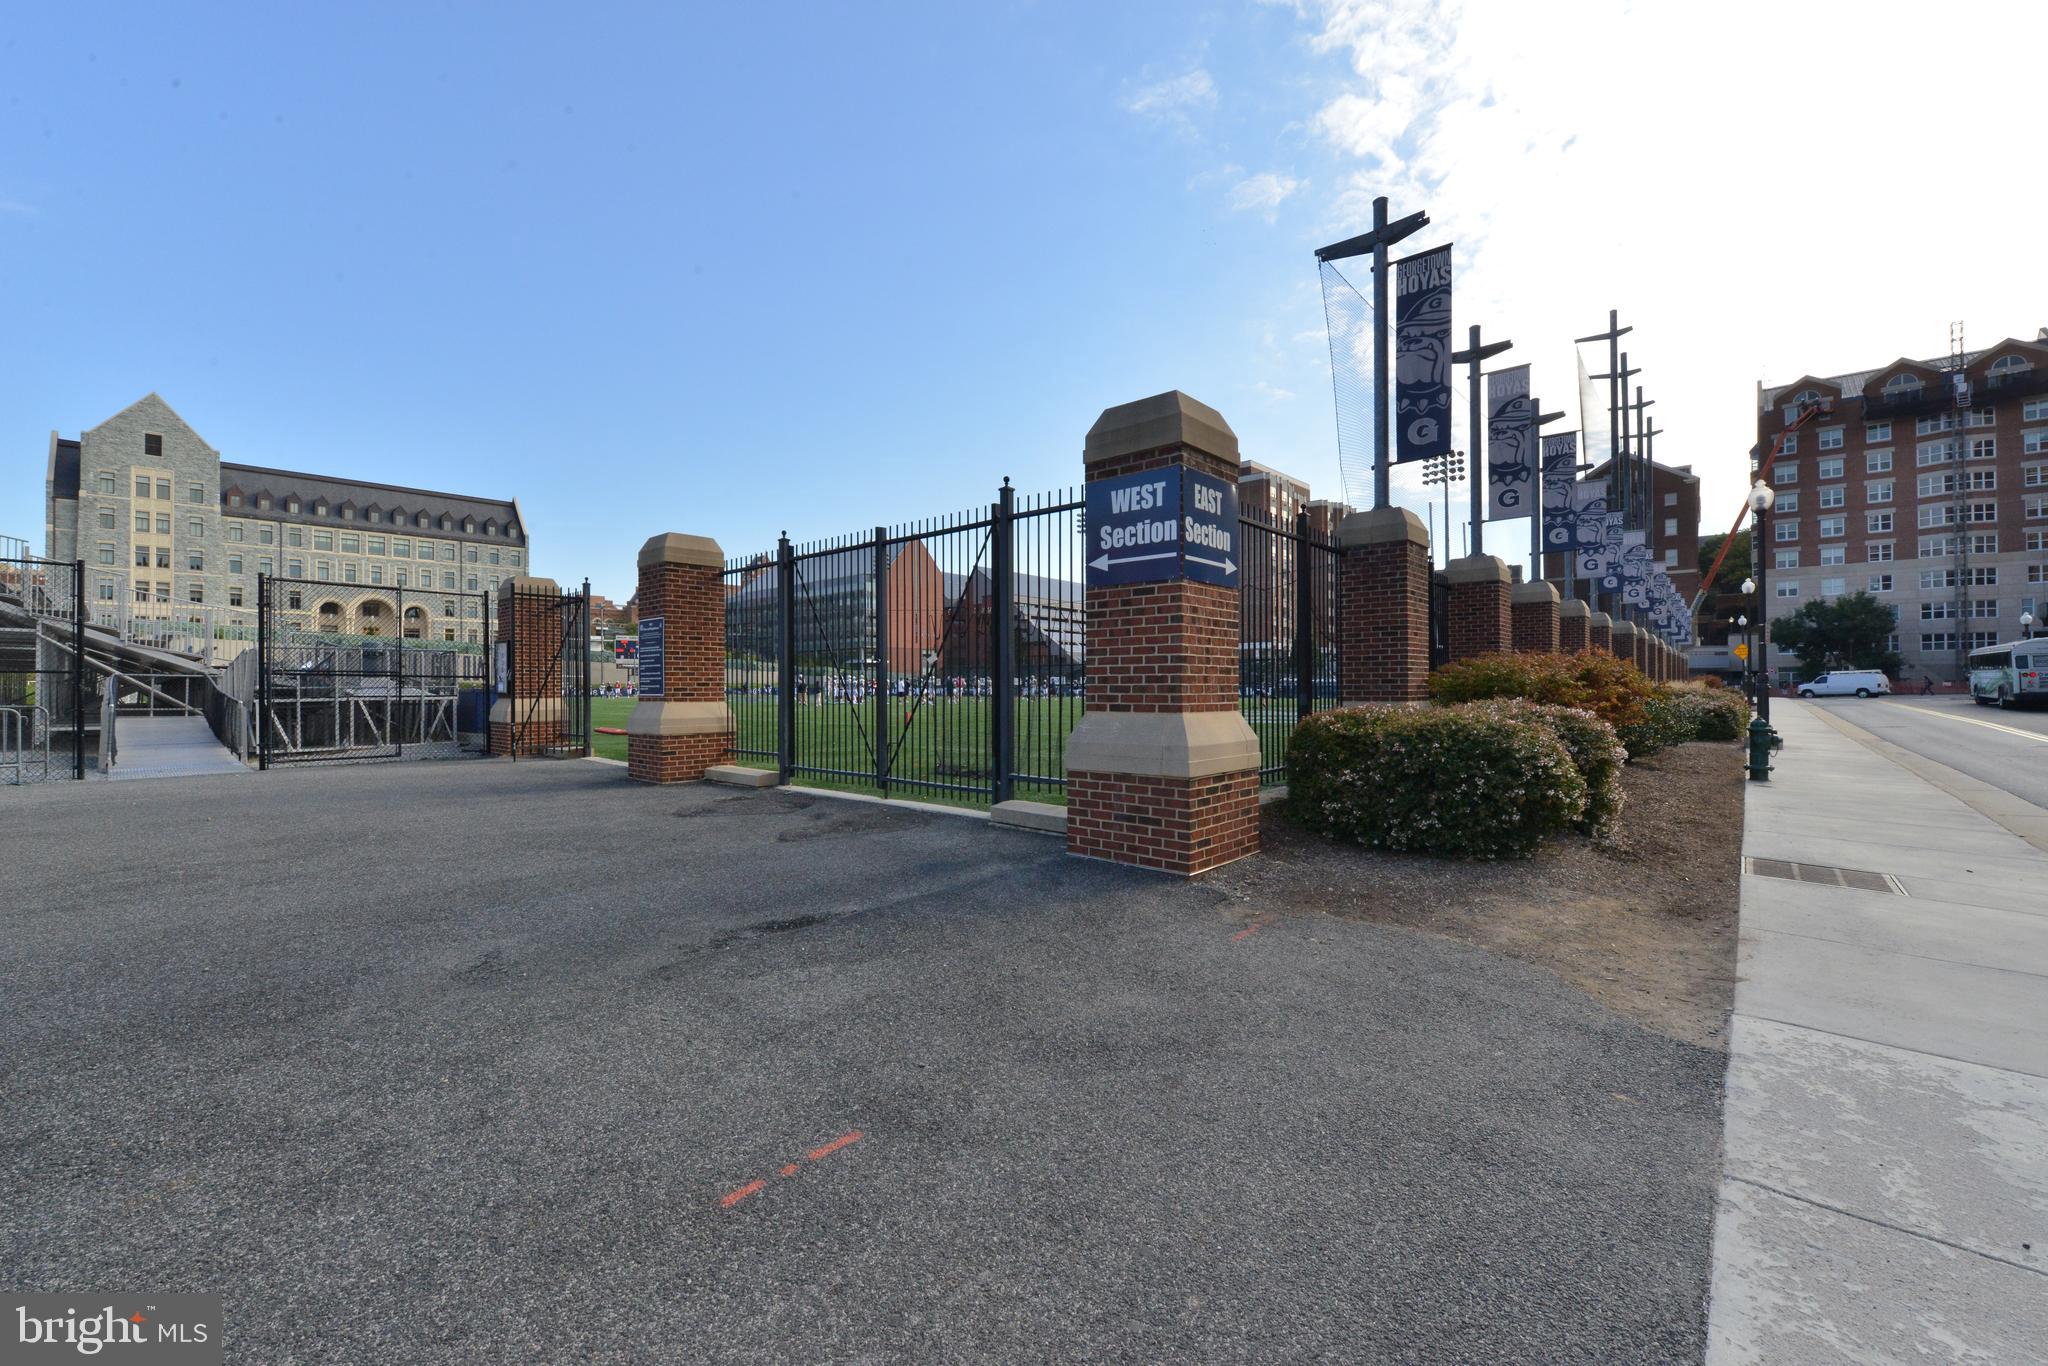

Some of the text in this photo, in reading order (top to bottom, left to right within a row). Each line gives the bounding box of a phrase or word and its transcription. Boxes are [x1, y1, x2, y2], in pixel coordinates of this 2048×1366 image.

[1397, 249, 1451, 279] GEORGETOWN
[1397, 265, 1451, 297] HOYAS
[1428, 297, 1441, 309] G
[1489, 378, 1529, 399] HOYAS
[1407, 417, 1439, 446] G
[1543, 442, 1577, 458] HOYAS
[1110, 481, 1166, 514] WEST
[1193, 483, 1223, 516] EAST
[1498, 488, 1520, 507] G
[1100, 519, 1178, 550] Section
[1185, 516, 1231, 552] Section
[1548, 527, 1570, 543] G
[1583, 558, 1600, 571] G
[1628, 588, 1640, 598] G
[1652, 607, 1663, 616] G
